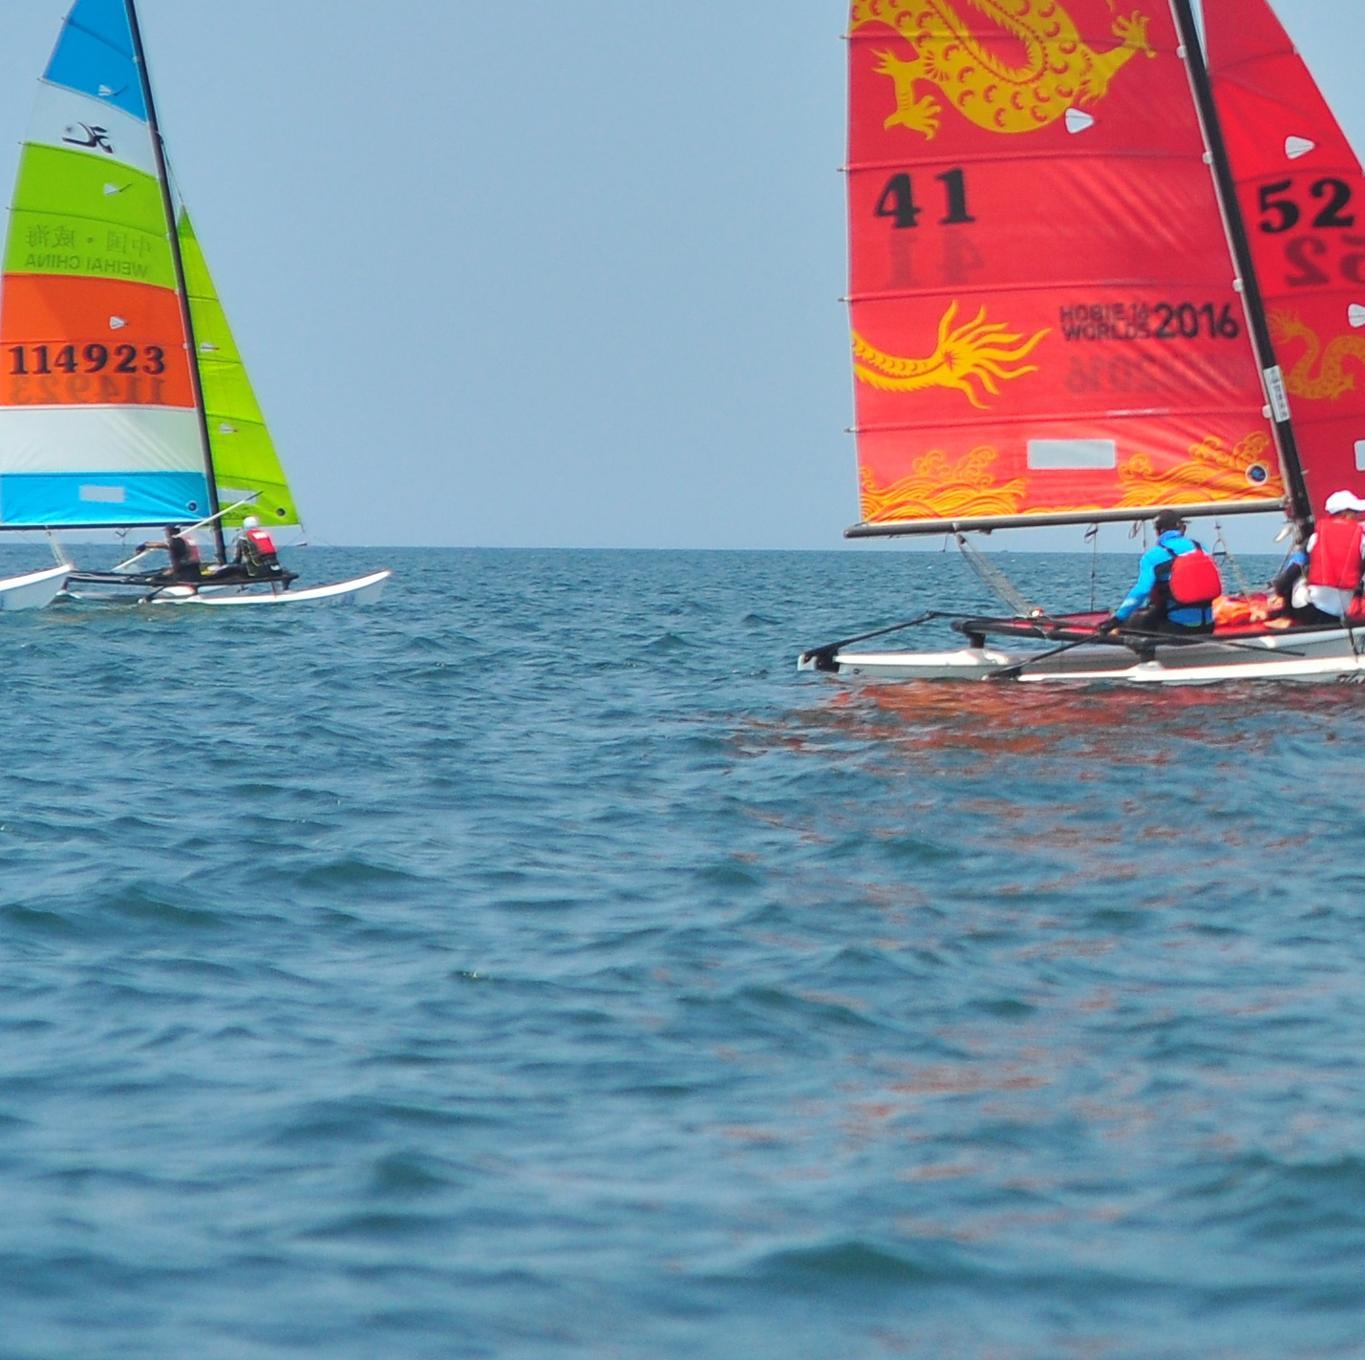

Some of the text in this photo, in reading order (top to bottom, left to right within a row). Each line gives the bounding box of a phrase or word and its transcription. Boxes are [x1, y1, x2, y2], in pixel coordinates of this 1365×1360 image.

[874, 167, 976, 229] 41
[1259, 178, 1355, 233] 52
[1154, 301, 1240, 339] 2016
[9, 343, 166, 375] 114923
